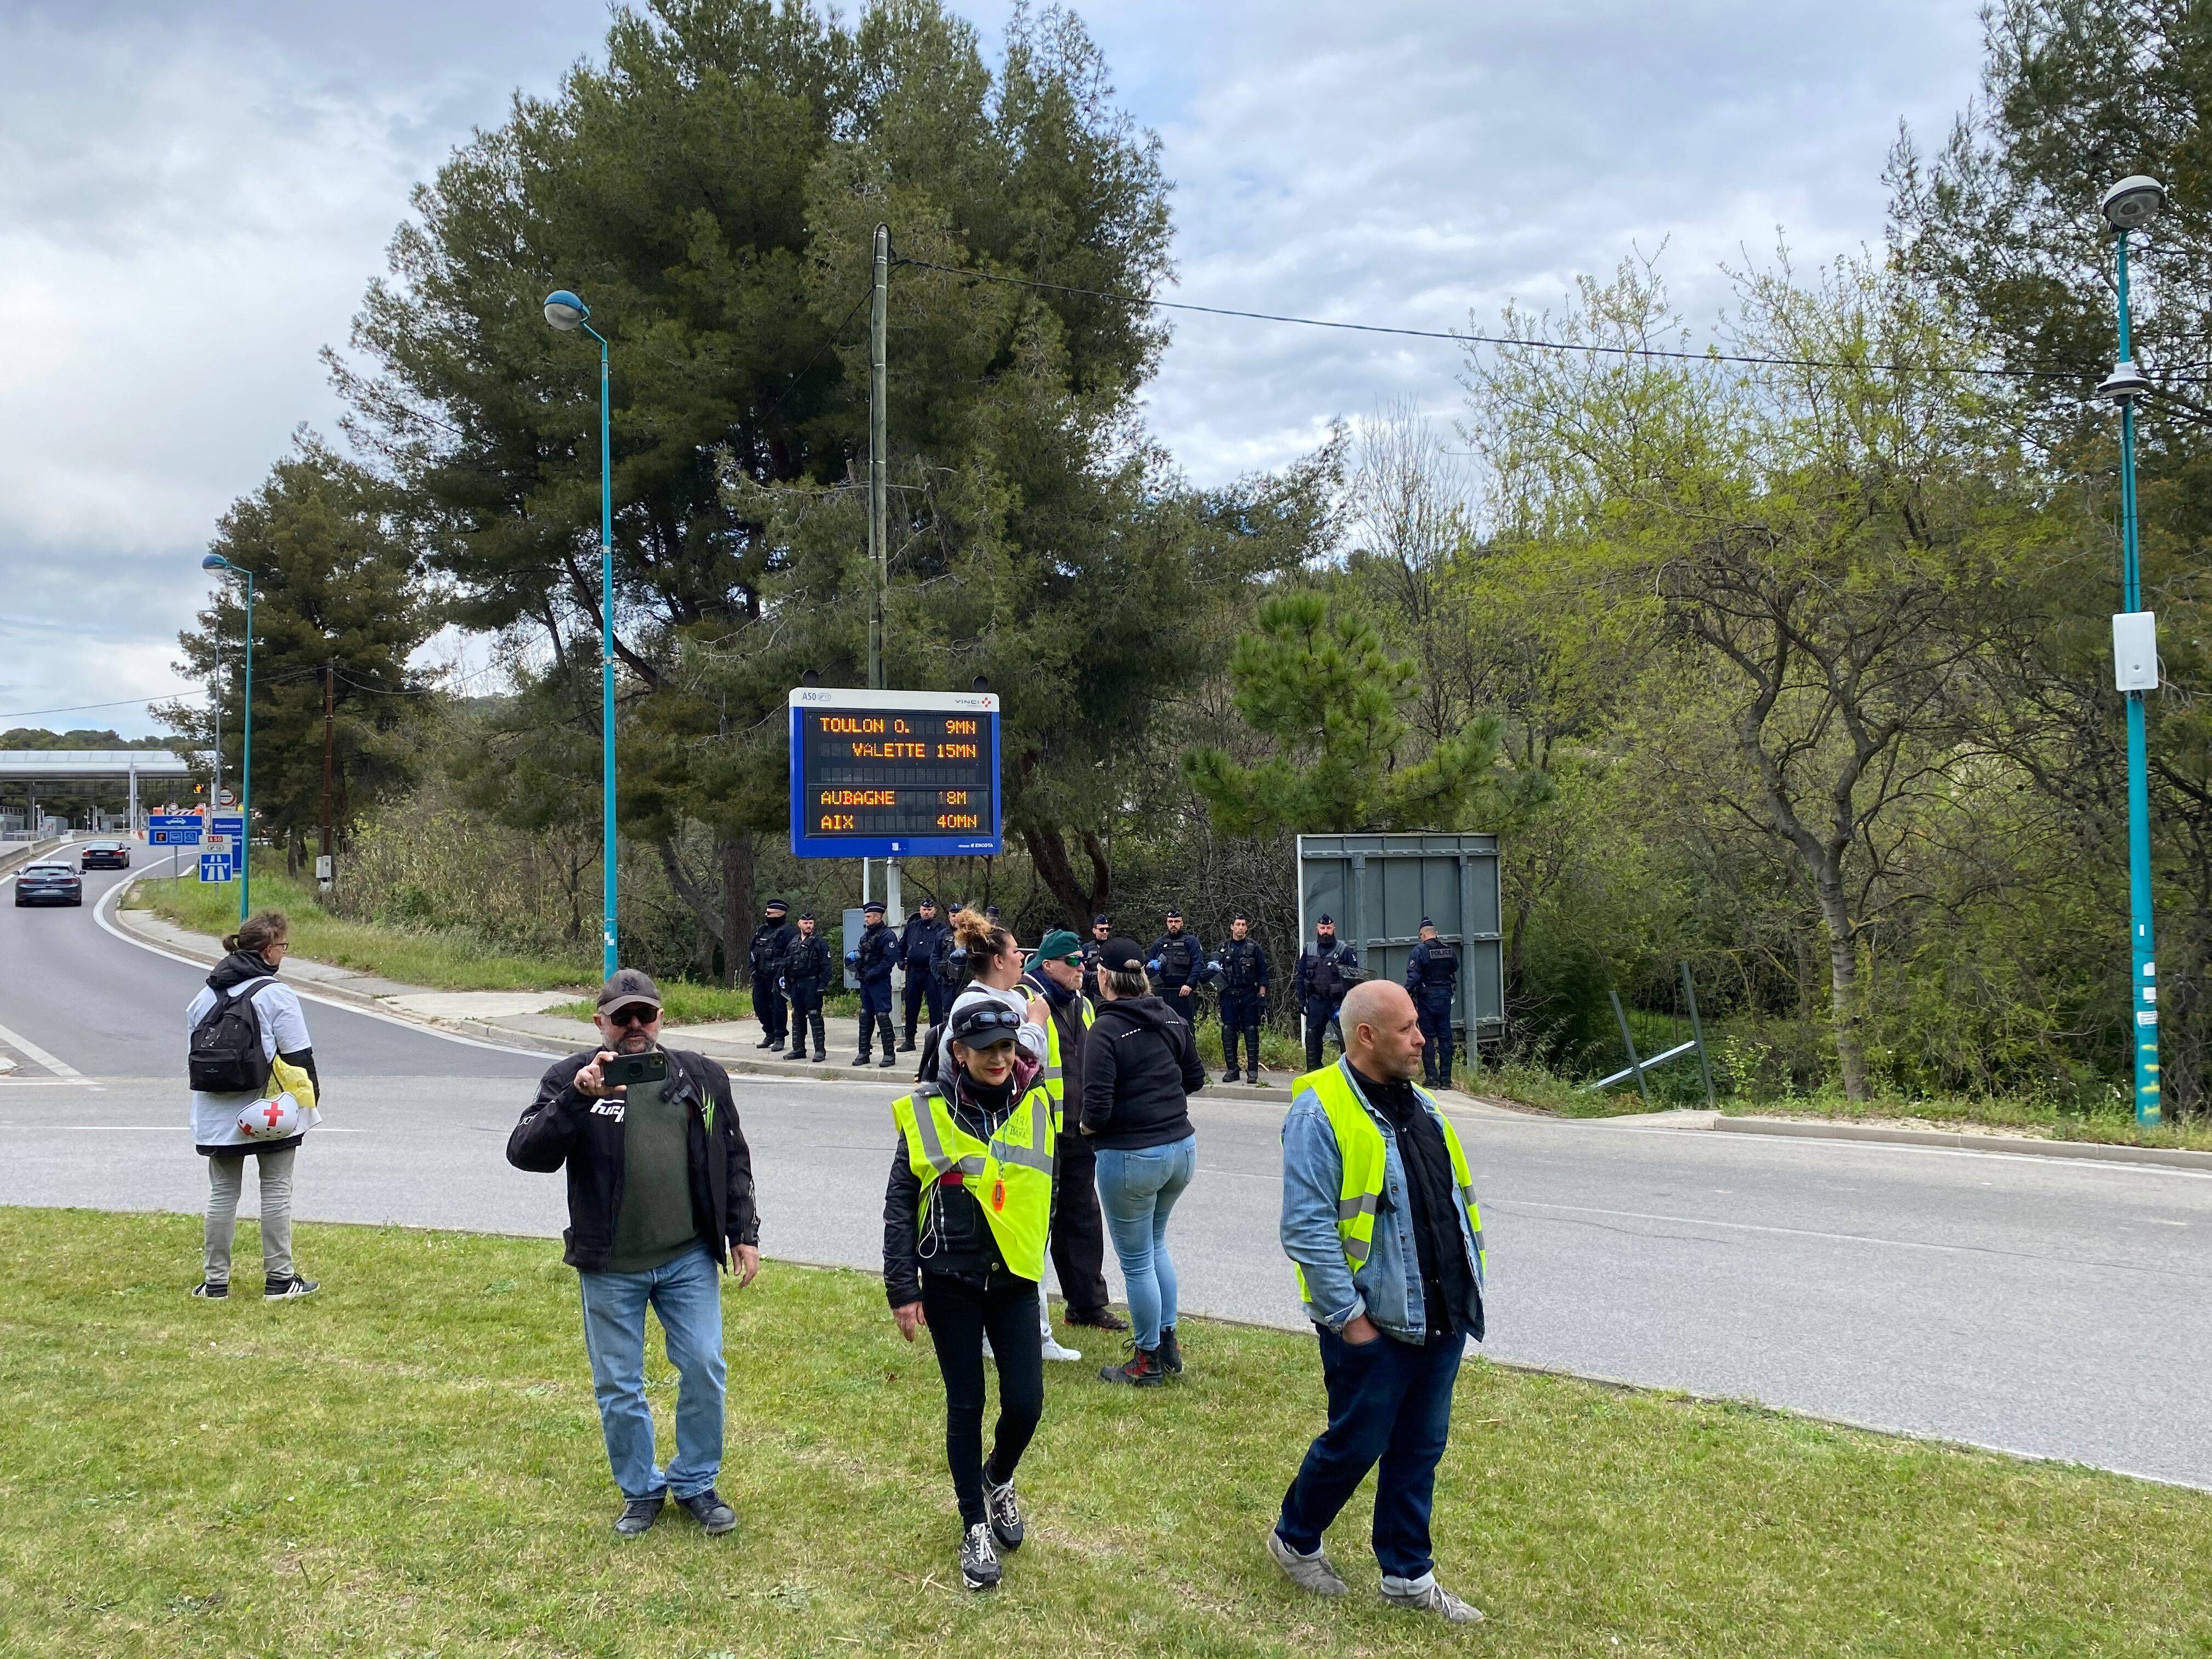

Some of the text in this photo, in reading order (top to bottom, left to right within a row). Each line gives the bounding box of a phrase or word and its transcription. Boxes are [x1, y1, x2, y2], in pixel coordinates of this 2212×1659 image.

[803, 692, 816, 701] A50
[820, 717, 885, 733] TOULON
[945, 720, 976, 734] 9MN
[852, 743, 976, 758] VALETTE 15MN
[821, 791, 895, 805] AUBAGNE
[821, 815, 977, 830] AIX 40MN
